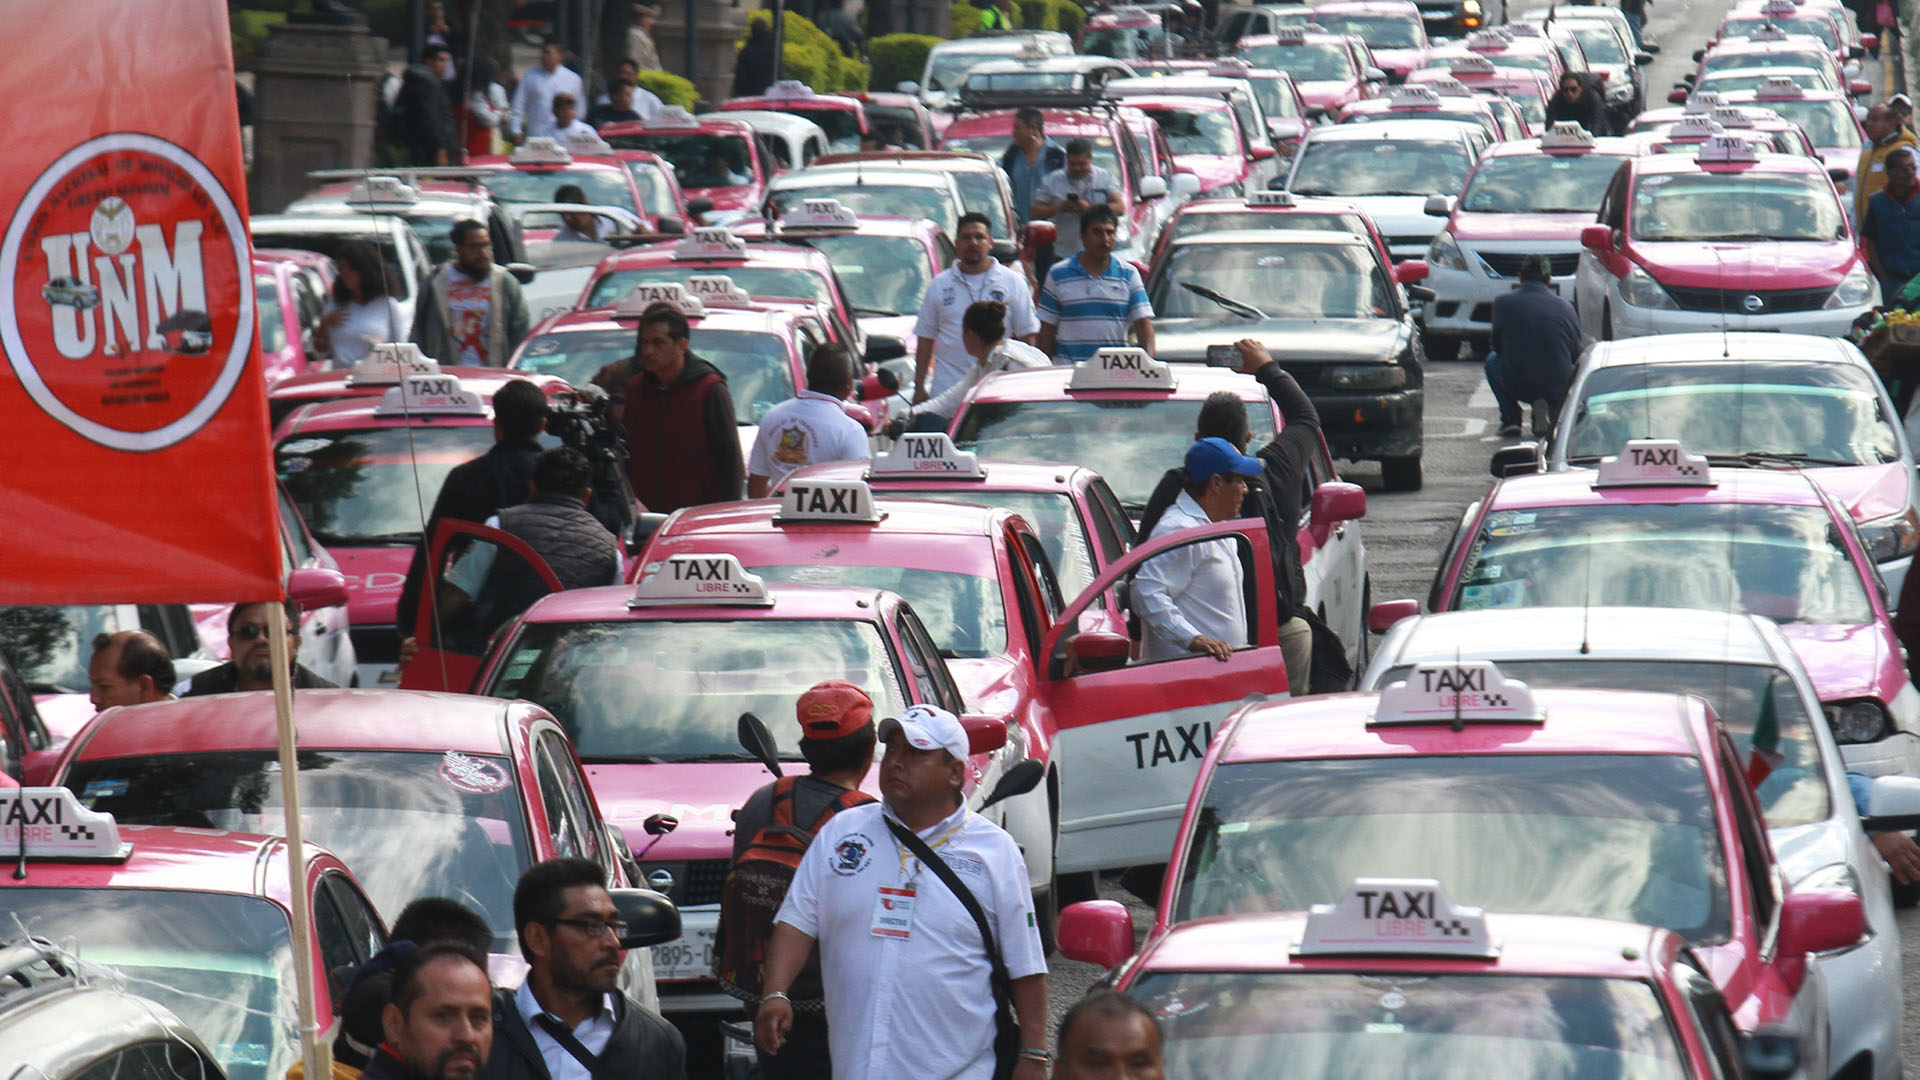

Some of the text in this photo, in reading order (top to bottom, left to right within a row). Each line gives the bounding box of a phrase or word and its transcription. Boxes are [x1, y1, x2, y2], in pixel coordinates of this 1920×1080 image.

[1553, 125, 1578, 136] TAXI
[1716, 137, 1739, 149] TAXI
[1258, 194, 1287, 203] TAXI
[805, 203, 836, 214] TAXI
[694, 232, 727, 244] TAXI
[638, 287, 679, 301] TAXI
[689, 280, 728, 293] TAXI
[373, 350, 412, 364] TAXI
[1100, 354, 1141, 370] TAXI
[410, 380, 452, 395] TAXI
[904, 438, 944, 459] TAXI
[1630, 448, 1678, 466] TAXI
[914, 461, 943, 470] LIBRE
[792, 487, 857, 513] TAXI
[669, 559, 730, 580] TAXI
[696, 583, 729, 592] LIBRE
[1419, 668, 1486, 692] TAXI
[1438, 694, 1481, 707] LIBRE
[1125, 721, 1212, 769] TAXI
[0, 797, 61, 825] TAXI
[5, 826, 54, 842] LIBRE
[1356, 890, 1436, 919] TAXI
[1376, 919, 1427, 937] LIBRE
